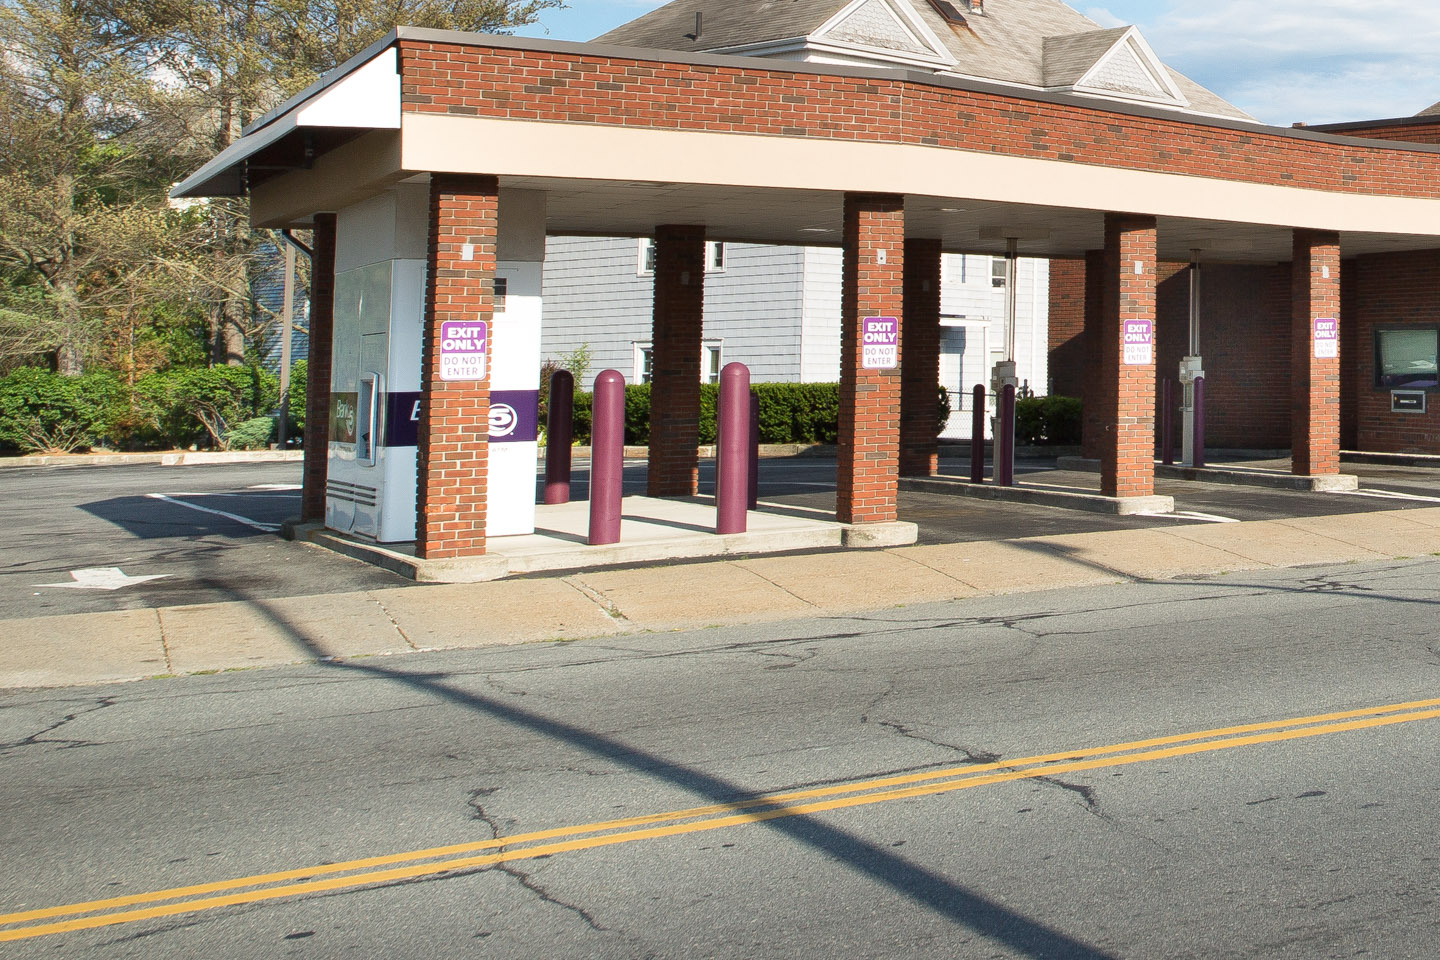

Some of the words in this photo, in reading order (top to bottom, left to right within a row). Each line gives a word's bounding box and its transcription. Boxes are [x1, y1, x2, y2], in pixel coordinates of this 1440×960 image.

[868, 322, 893, 332] EXIT
[1128, 324, 1148, 332] EXIT
[1317, 322, 1334, 330] EXIT
[448, 327, 480, 338] EXIT
[1315, 330, 1336, 338] ONLY
[864, 333, 896, 343] ONLY
[1125, 333, 1151, 342] ONLY
[443, 339, 485, 350] ONLY
[1126, 345, 1135, 353] DO
[1137, 345, 1149, 353] NOT
[879, 347, 894, 355] NOT
[444, 357, 458, 365] DO
[462, 356, 481, 365] NOT
[868, 357, 890, 365] ENTER
[447, 367, 478, 376] ENTER
